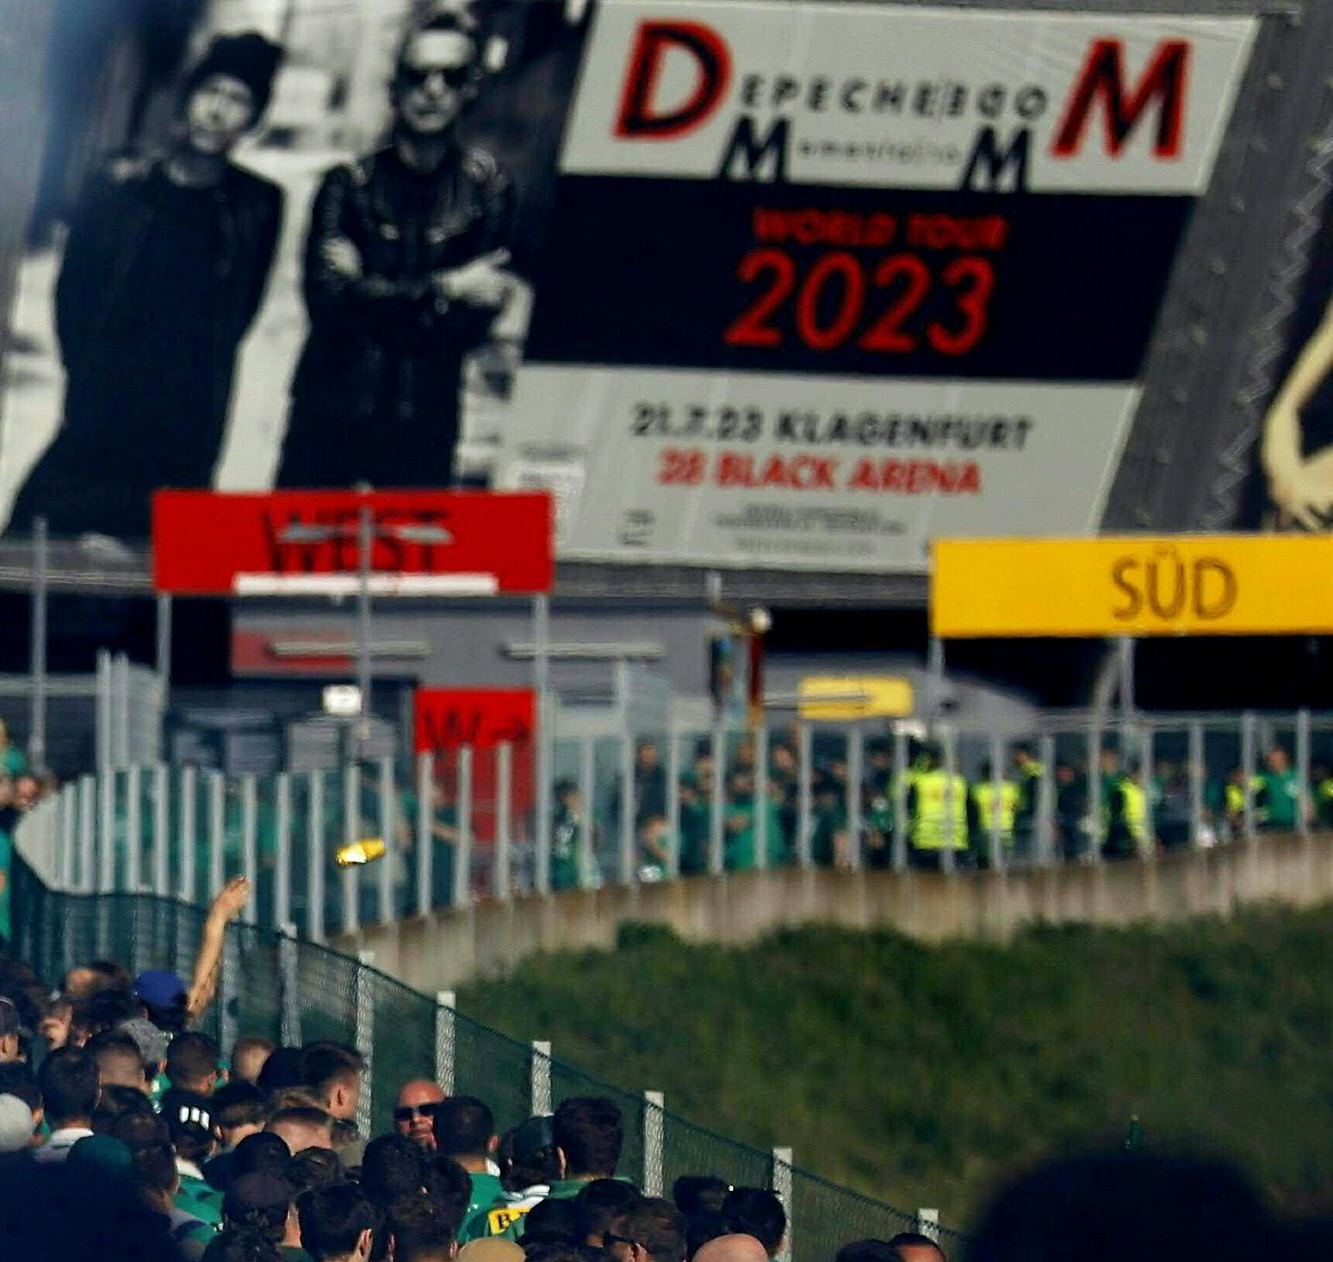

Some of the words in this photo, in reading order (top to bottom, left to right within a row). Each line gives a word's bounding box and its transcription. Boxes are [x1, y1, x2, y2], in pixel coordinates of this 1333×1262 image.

[753, 207, 896, 246] WORLD
[907, 212, 1009, 249] TOUR
[724, 249, 994, 355] 2023
[633, 403, 763, 441] 21.7.23
[774, 408, 1032, 450] KLAGENFURT
[714, 451, 836, 489] BLACK
[848, 457, 982, 494] ARENA
[1110, 543, 1238, 621] SÜD
